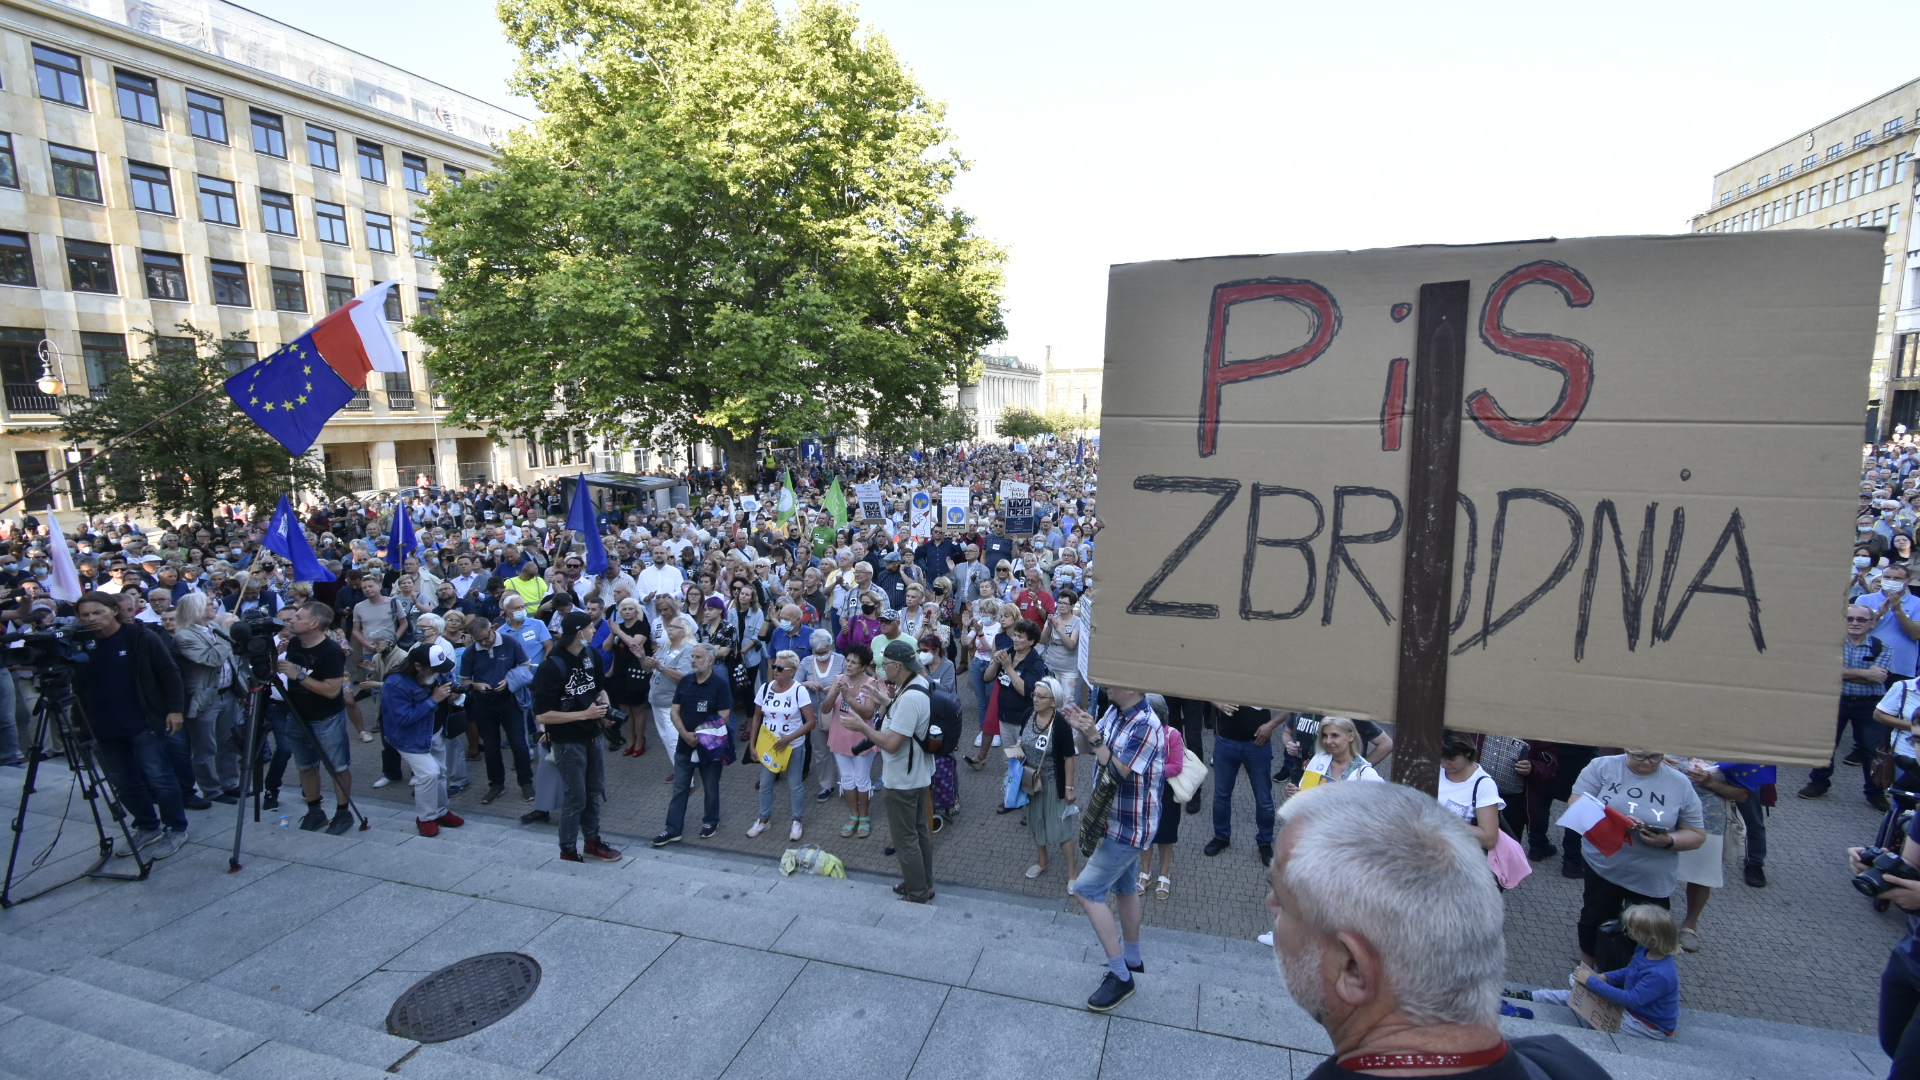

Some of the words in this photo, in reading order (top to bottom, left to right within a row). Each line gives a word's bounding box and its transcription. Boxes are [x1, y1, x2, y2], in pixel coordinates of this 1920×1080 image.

[1010, 499, 1031, 507] TVP
[764, 699, 792, 708] KON
[1608, 782, 1665, 806] KON
